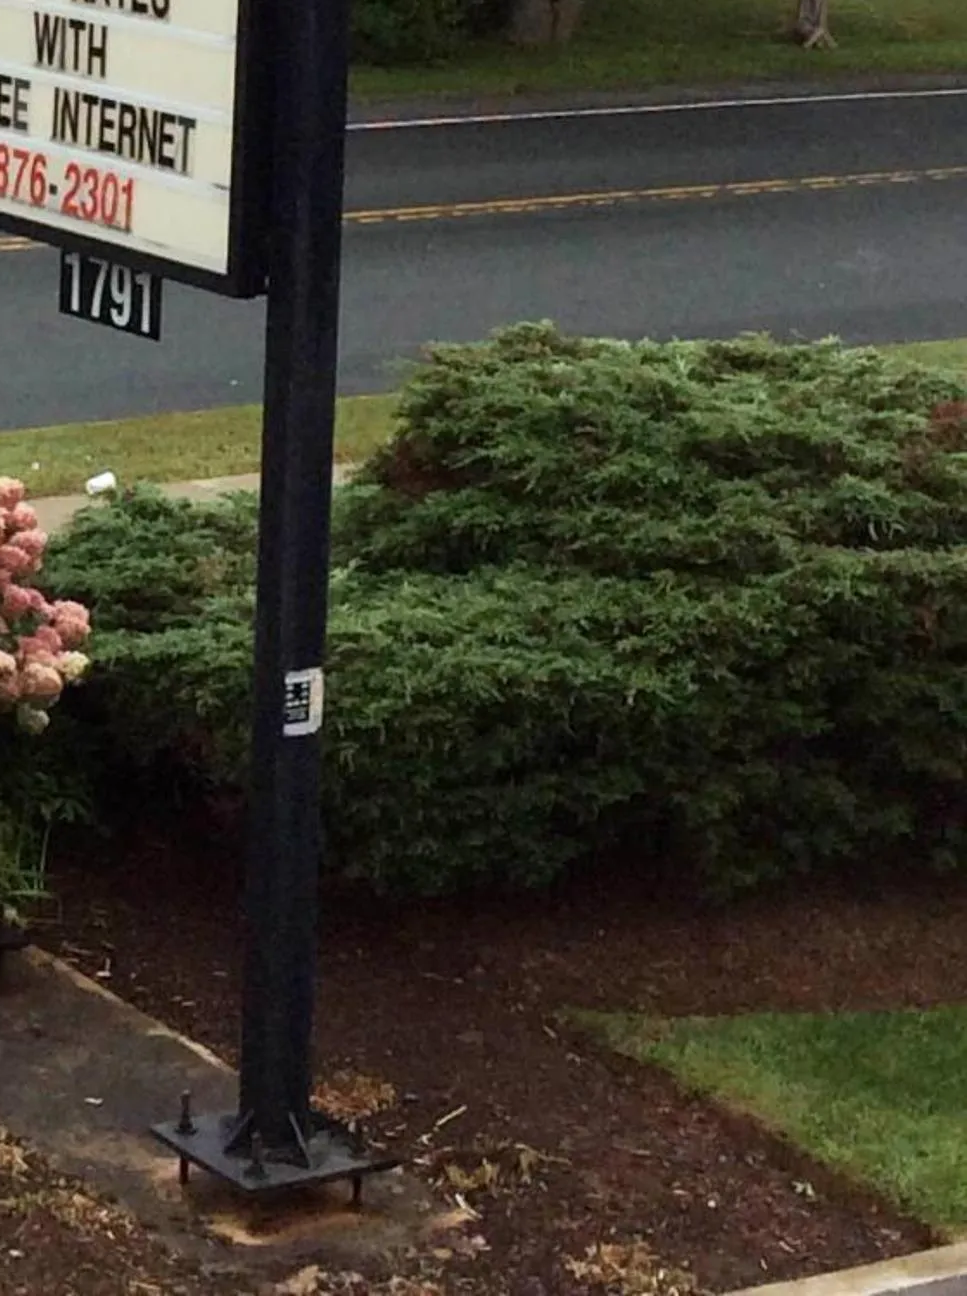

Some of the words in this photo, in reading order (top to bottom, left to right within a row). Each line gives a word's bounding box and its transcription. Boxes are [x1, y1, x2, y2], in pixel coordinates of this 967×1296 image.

[34, 12, 107, 78] WITH
[52, 87, 196, 174] INTERNET
[65, 253, 153, 334] 1791
